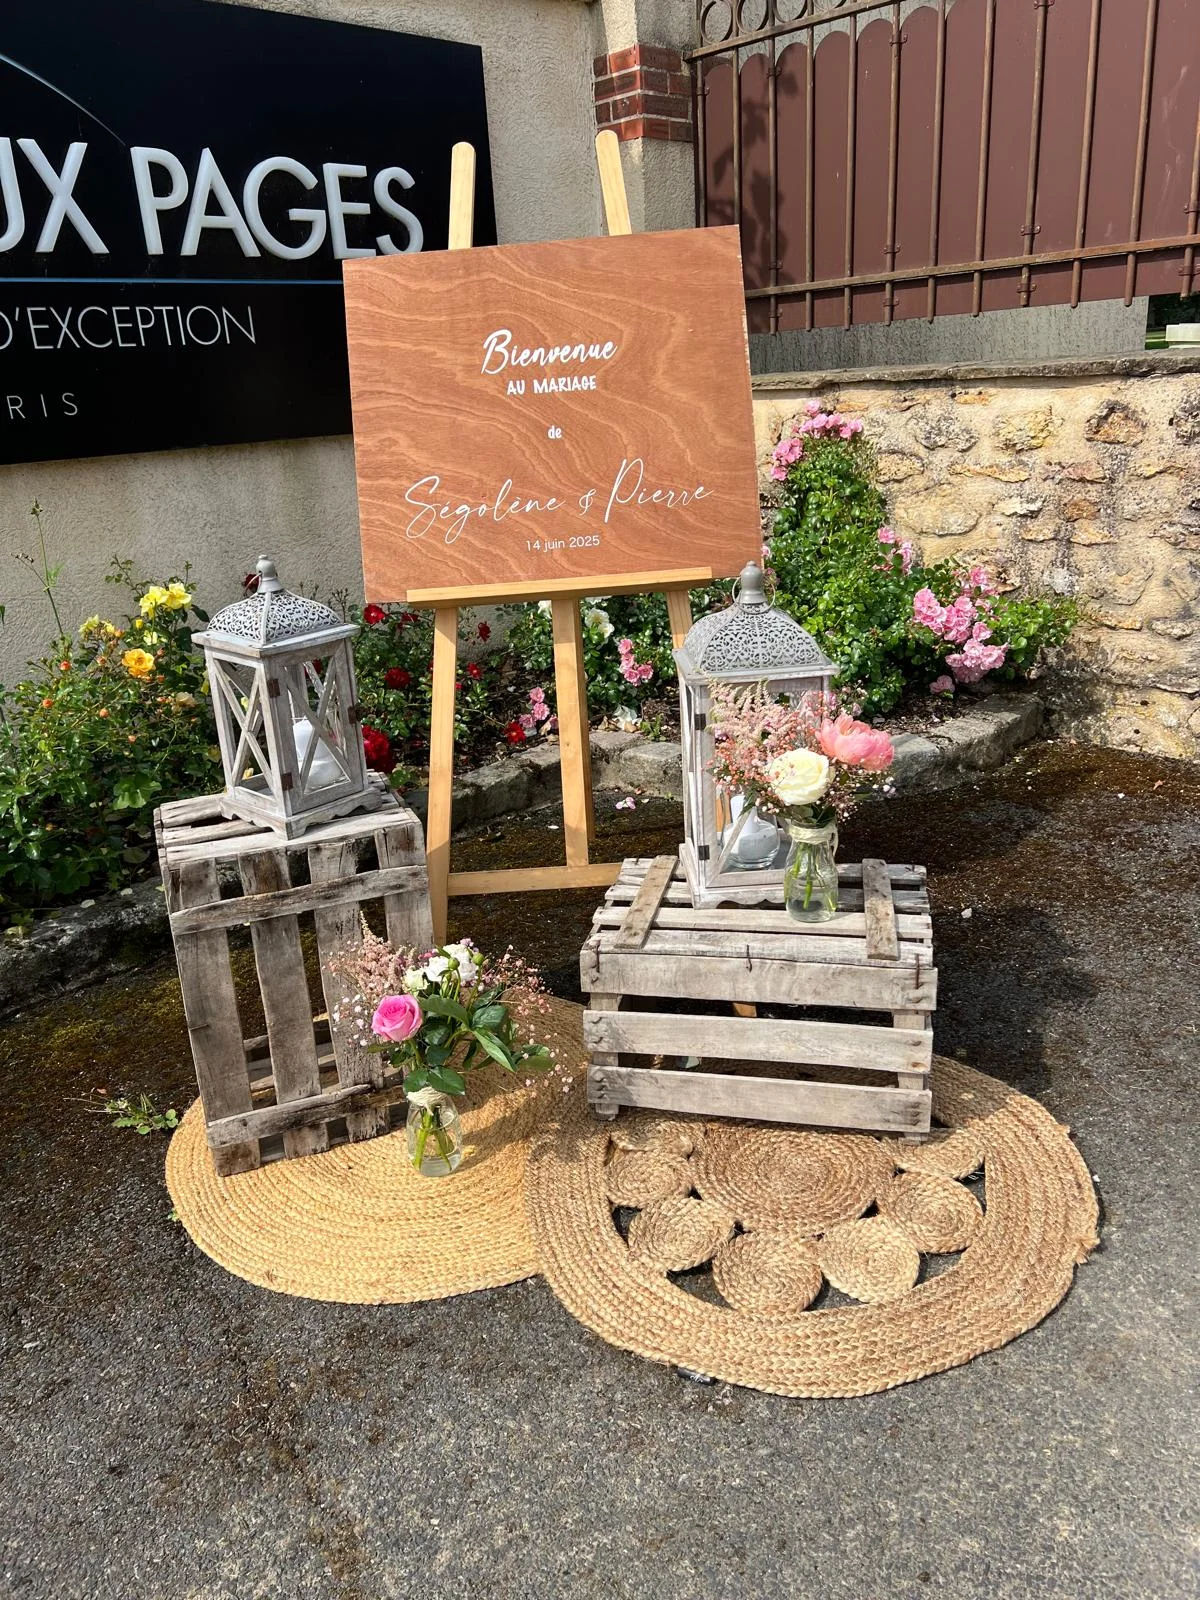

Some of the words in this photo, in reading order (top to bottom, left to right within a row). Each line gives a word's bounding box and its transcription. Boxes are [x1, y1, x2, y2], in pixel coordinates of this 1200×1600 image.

[130, 147, 424, 260] PAGES
[480, 329, 618, 375] Bienvenue
[506, 379, 526, 396] AU
[532, 374, 597, 394] MARIAGE
[6, 392, 79, 420] RIS
[547, 425, 562, 439] de
[404, 475, 566, 544] Ségolène
[577, 488, 597, 517] &
[603, 457, 715, 523] Pierre
[526, 539, 542, 552] 14
[542, 538, 566, 553] juin
[568, 534, 601, 549] 2025
